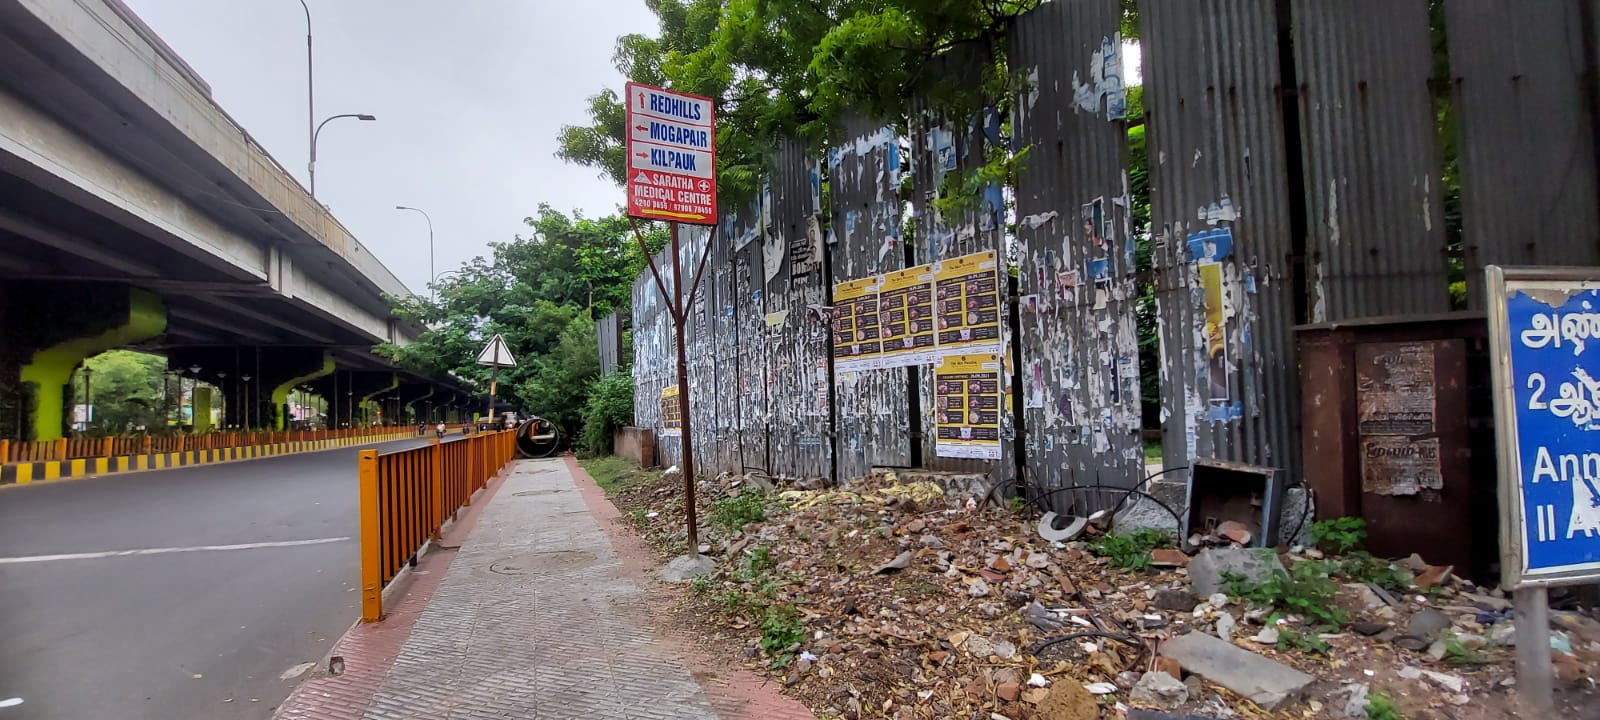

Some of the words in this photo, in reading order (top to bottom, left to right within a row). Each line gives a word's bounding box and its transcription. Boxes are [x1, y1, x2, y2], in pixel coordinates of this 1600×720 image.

[650, 93, 701, 120] REDHILLS
[650, 121, 708, 148] MOGAPAIR
[651, 148, 697, 171] KILPAUK
[653, 173, 694, 190] SARATHA
[634, 185, 675, 202] MEDICAL
[677, 190, 712, 206] CENTRE
